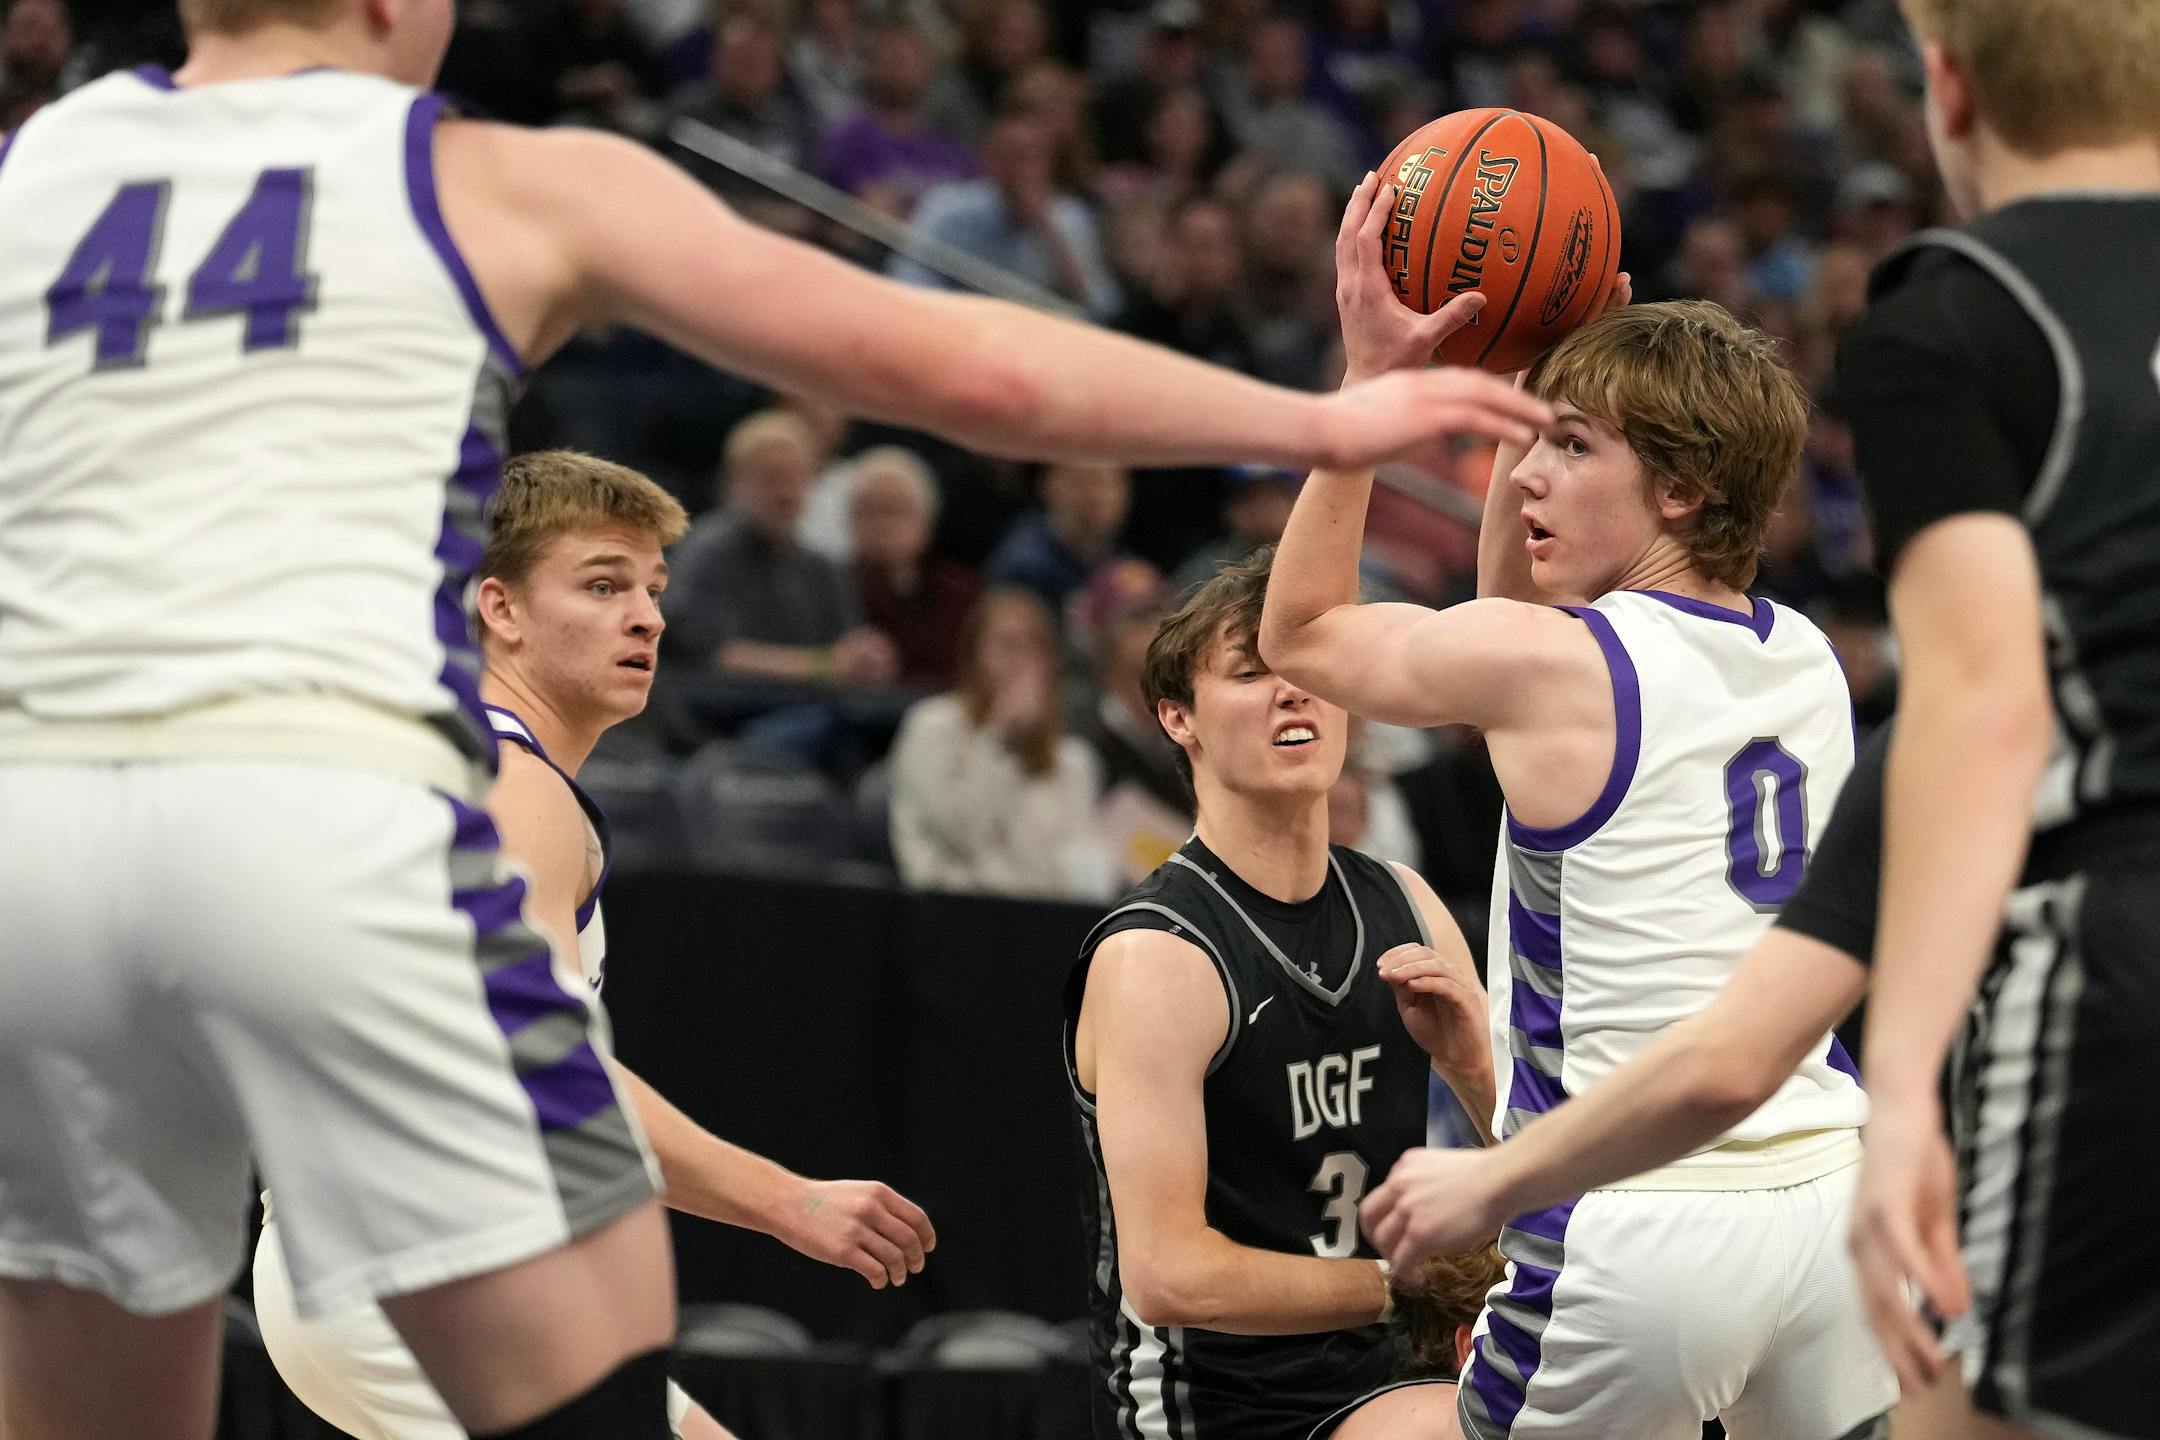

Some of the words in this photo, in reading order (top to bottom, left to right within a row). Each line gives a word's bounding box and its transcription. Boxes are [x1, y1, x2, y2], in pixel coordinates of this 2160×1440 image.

[43, 165, 320, 373] 44
[1390, 146, 1448, 296] LEGACY
[1722, 735, 1811, 915] 0
[1286, 1043, 1381, 1142] DGF
[1306, 1150, 1370, 1259] 3
